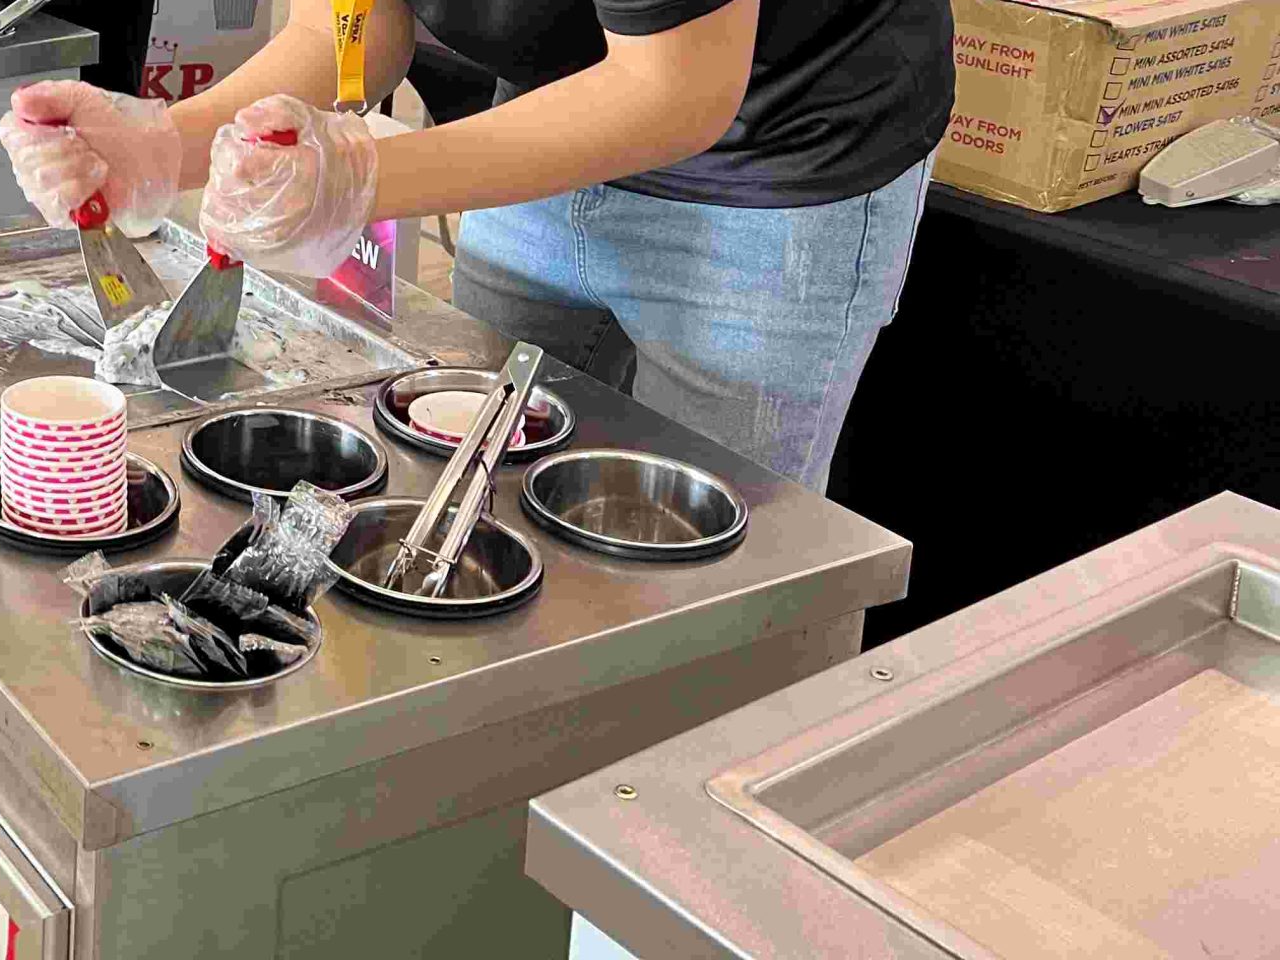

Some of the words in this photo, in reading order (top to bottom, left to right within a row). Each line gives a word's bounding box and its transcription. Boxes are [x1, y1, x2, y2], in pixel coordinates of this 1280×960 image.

[1145, 28, 1169, 43] MINI
[1169, 20, 1201, 39] WHITE
[954, 34, 987, 51] WAY
[990, 43, 1035, 63] FROM
[1133, 57, 1157, 71] MINI
[1157, 44, 1208, 66] ASSORTED
[956, 52, 1032, 79] SUNLIGHT
[1128, 77, 1151, 91] MINI
[1151, 70, 1173, 85] MINI
[1174, 62, 1206, 81] WHITE
[1119, 103, 1142, 117] MINI
[1142, 97, 1165, 113] MINI
[1164, 83, 1215, 107] ASSORTED
[950, 113, 974, 129] AY
[977, 120, 1022, 141] FROM
[1113, 121, 1157, 138] FLOWER
[951, 131, 1005, 154] ODORS
[1103, 145, 1142, 165] HEARTS
